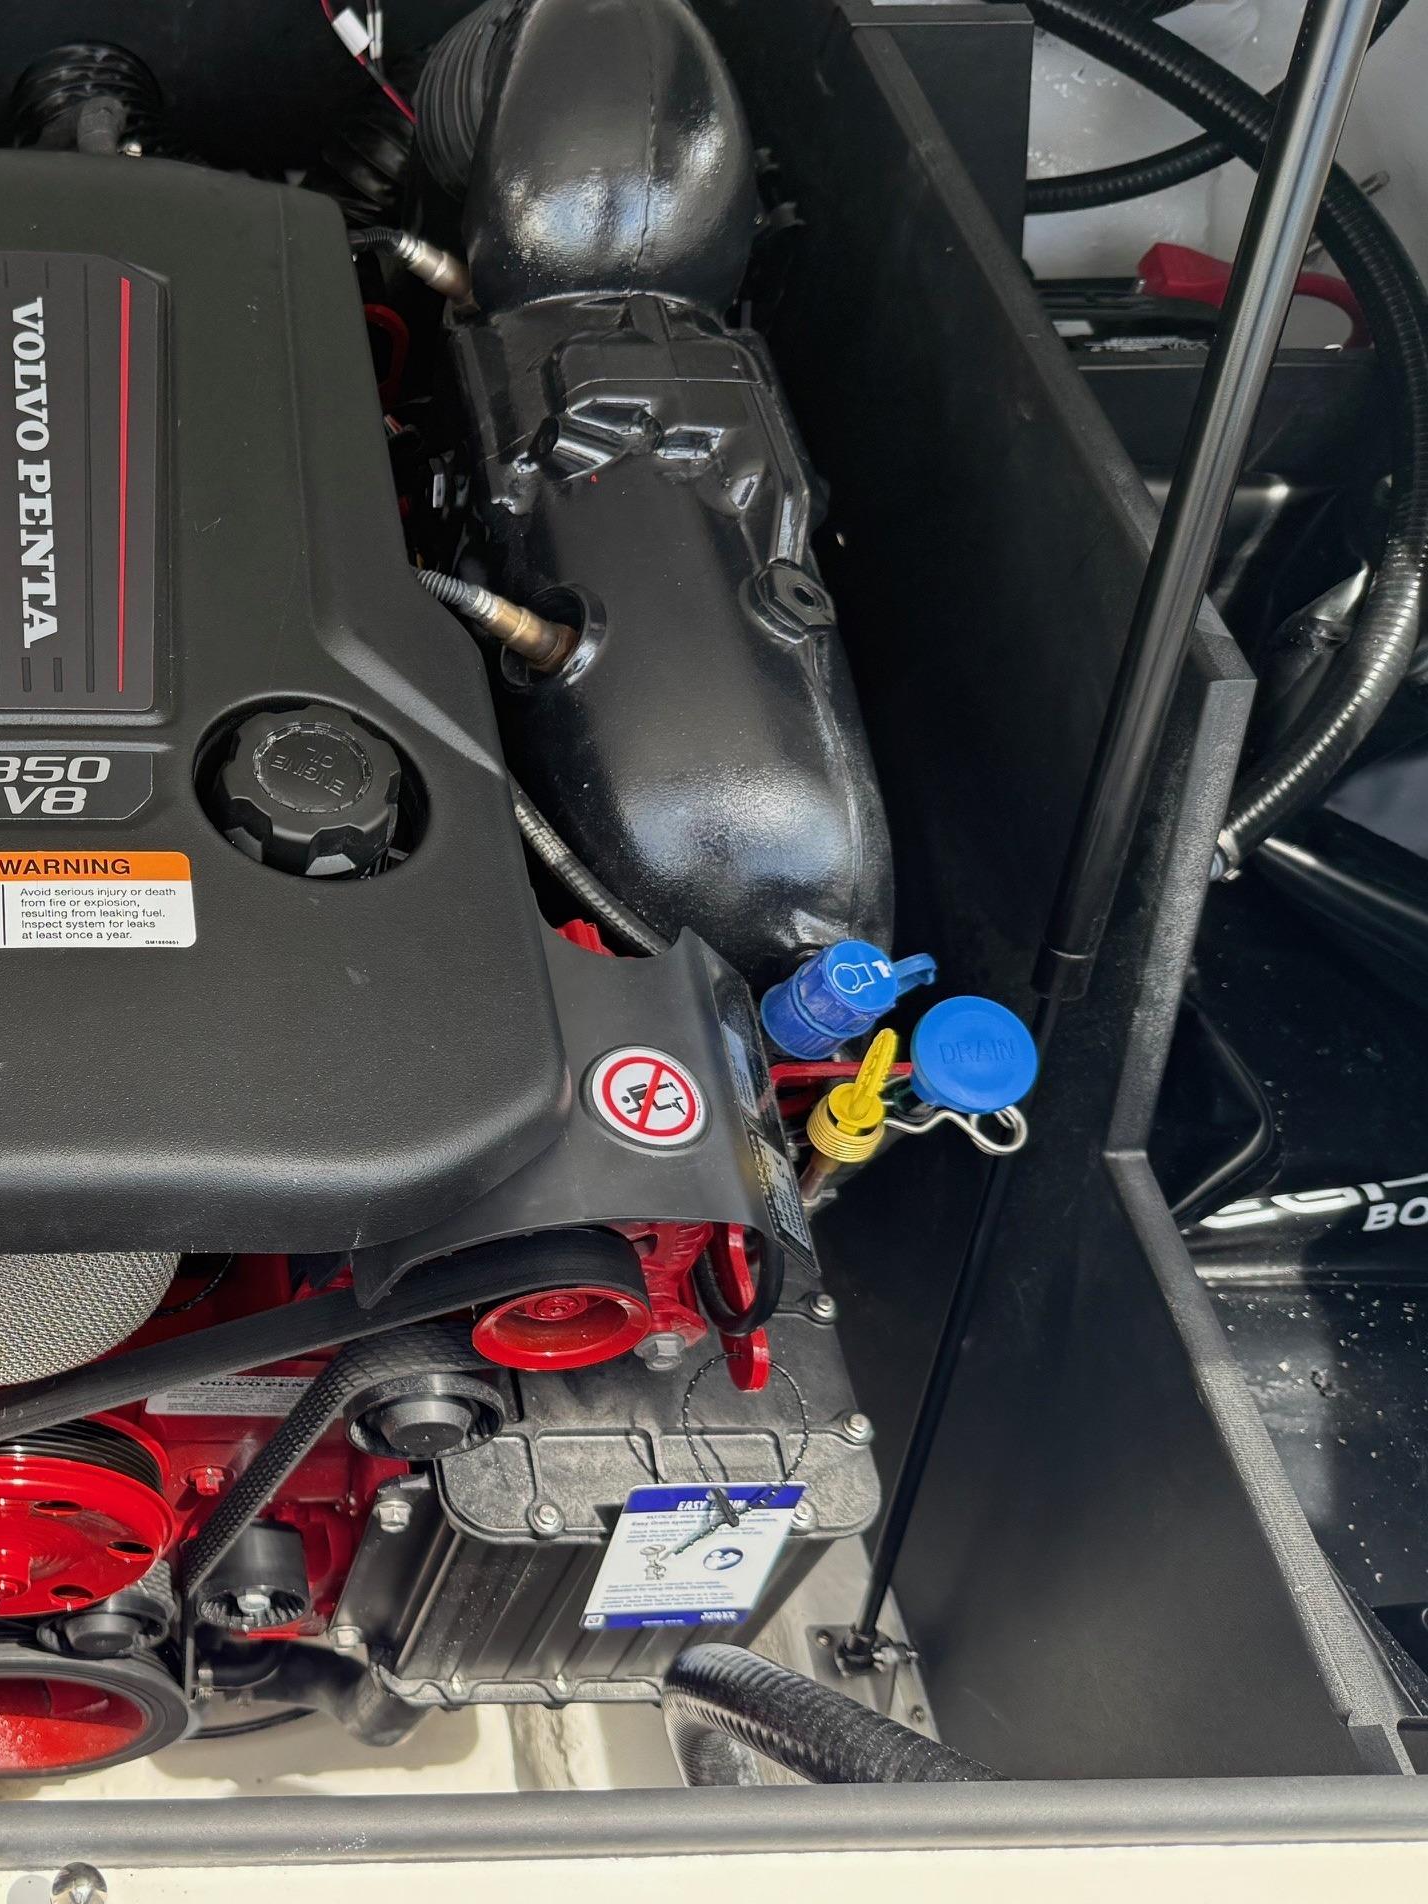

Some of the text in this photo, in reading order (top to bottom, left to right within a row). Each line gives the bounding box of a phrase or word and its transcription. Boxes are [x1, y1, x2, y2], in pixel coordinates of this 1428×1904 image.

[12, 297, 58, 649] VOLVO PENTA
[3, 786, 88, 815] V8
[20, 888, 51, 896] Avoid
[54, 888, 94, 896] serious
[97, 888, 127, 899] injury
[145, 888, 176, 896] death
[21, 899, 46, 907] from
[49, 899, 66, 907] fire
[84, 899, 140, 909] explosion,
[21, 909, 165, 919] resulting from leaking fuel.
[22, 920, 156, 930] Inspect system for leaks
[22, 931, 33, 940] at
[36, 931, 62, 939] least
[106, 932, 132, 942] year.
[939, 1037, 1016, 1065] DRAIN
[676, 1500, 708, 1511] EASY
